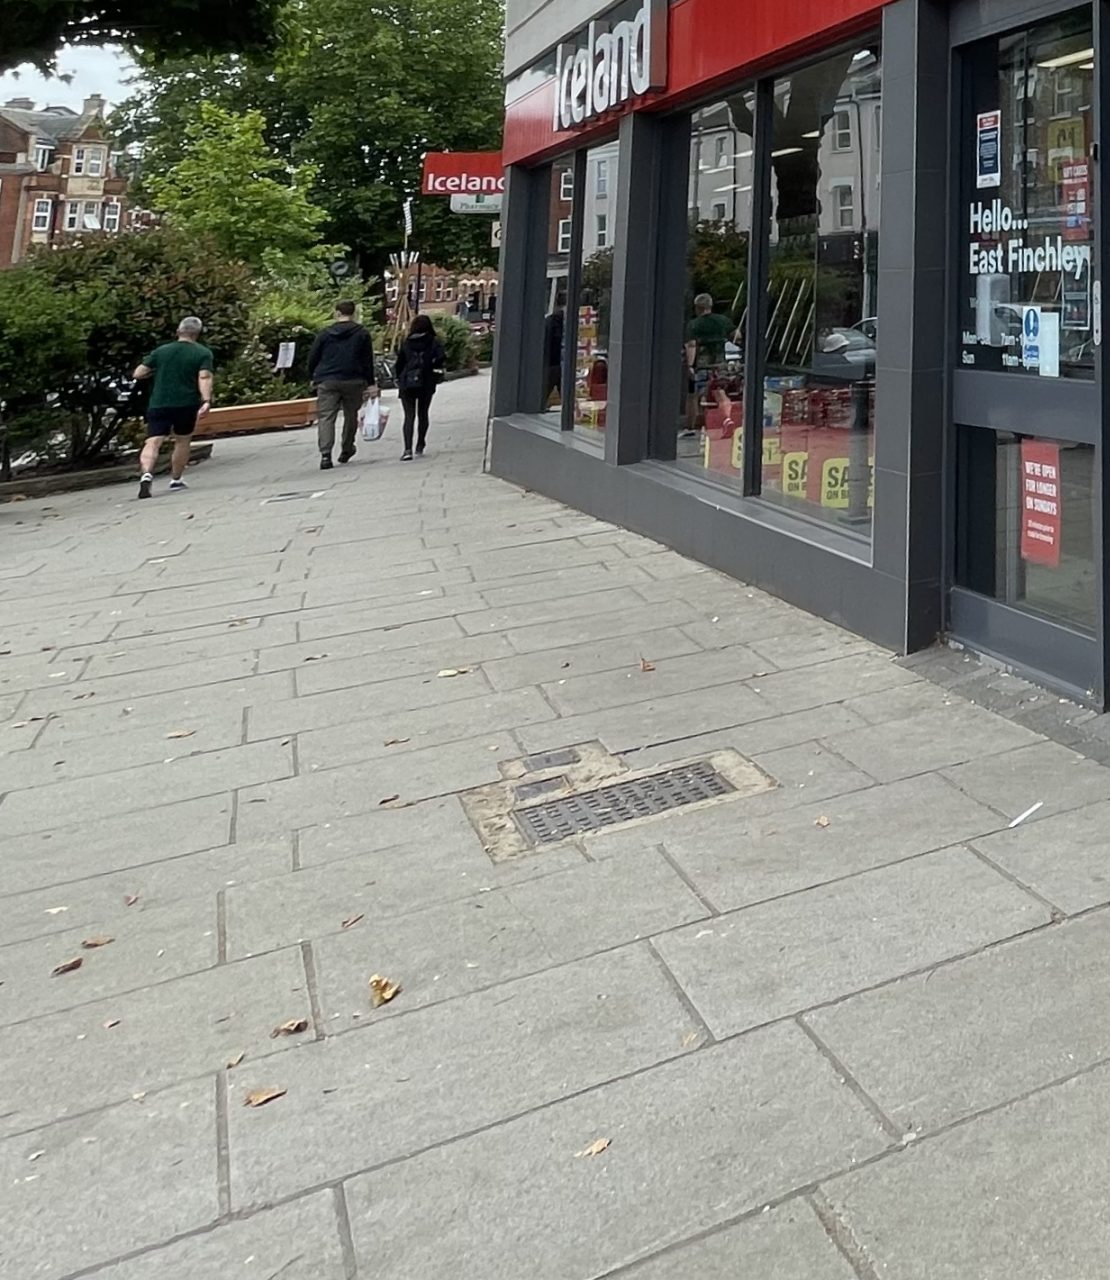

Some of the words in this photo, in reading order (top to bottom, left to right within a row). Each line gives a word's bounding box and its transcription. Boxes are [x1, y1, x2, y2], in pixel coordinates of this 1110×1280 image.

[969, 199, 1029, 233] Hello...
[969, 242, 1003, 274] East
[1008, 236, 1091, 280] Finchley
[827, 466, 850, 489] SA
